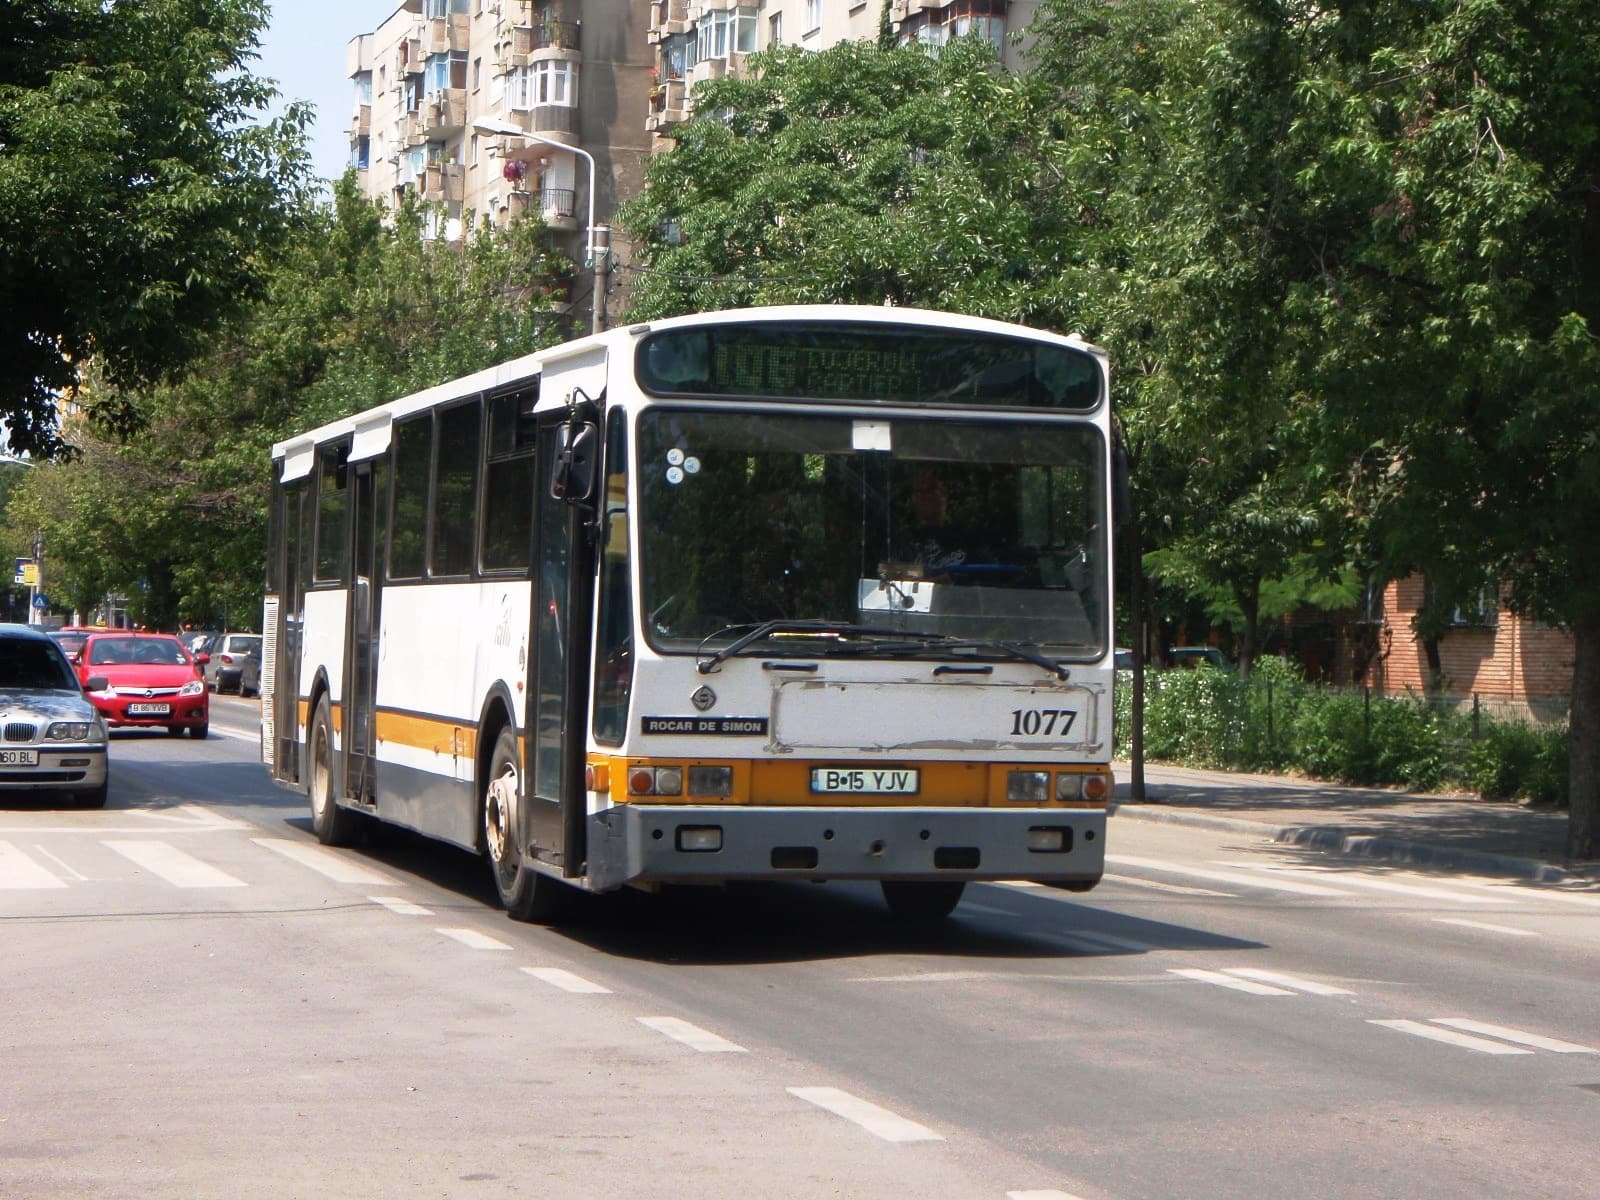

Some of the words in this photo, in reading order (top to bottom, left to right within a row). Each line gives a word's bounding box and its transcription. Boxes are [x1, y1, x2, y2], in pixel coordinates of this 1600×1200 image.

[649, 721, 693, 731] ROCAR
[699, 721, 716, 731] DE
[722, 722, 761, 732] SIMON
[1010, 709, 1078, 736] 1077
[847, 771, 865, 790] 15
[872, 772, 909, 790] YJV
